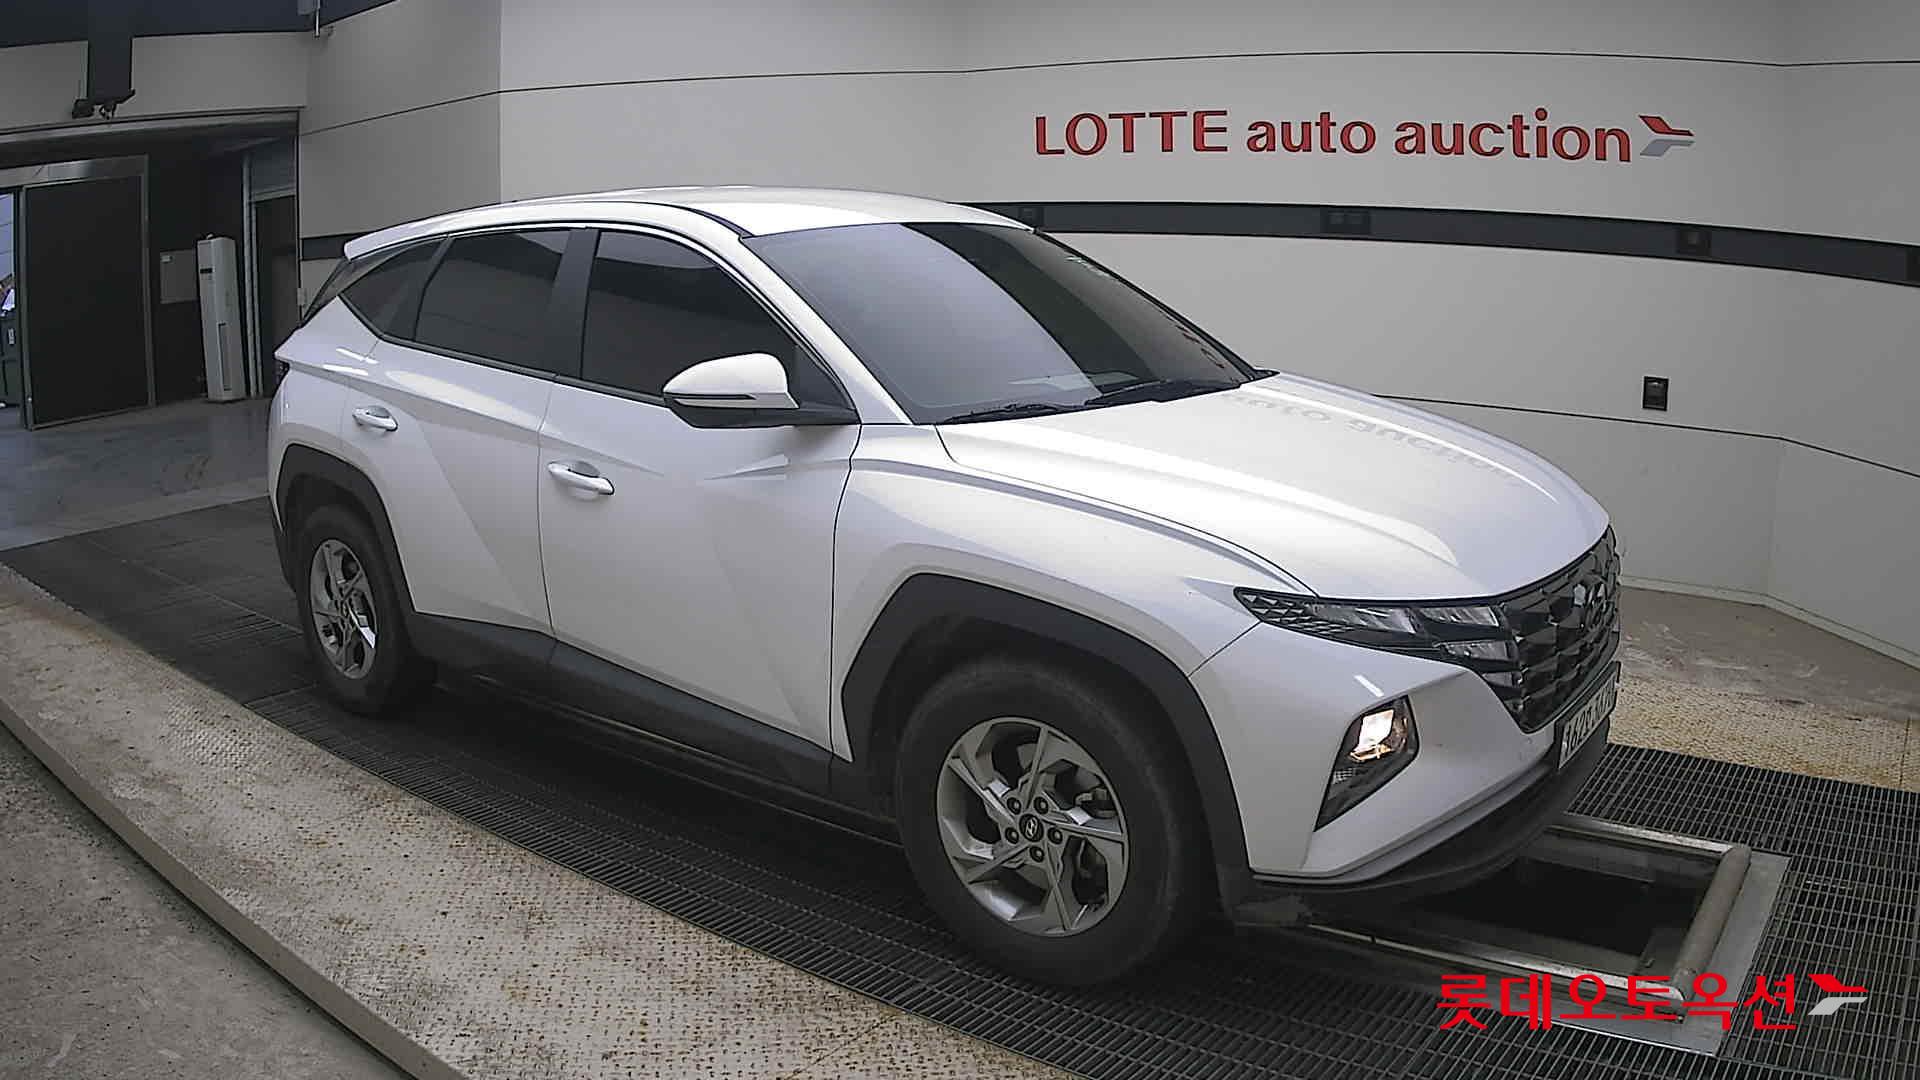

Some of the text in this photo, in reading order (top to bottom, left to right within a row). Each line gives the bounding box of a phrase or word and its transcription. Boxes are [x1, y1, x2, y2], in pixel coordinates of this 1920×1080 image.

[1035, 108, 1632, 162] LOTTE auto auction
